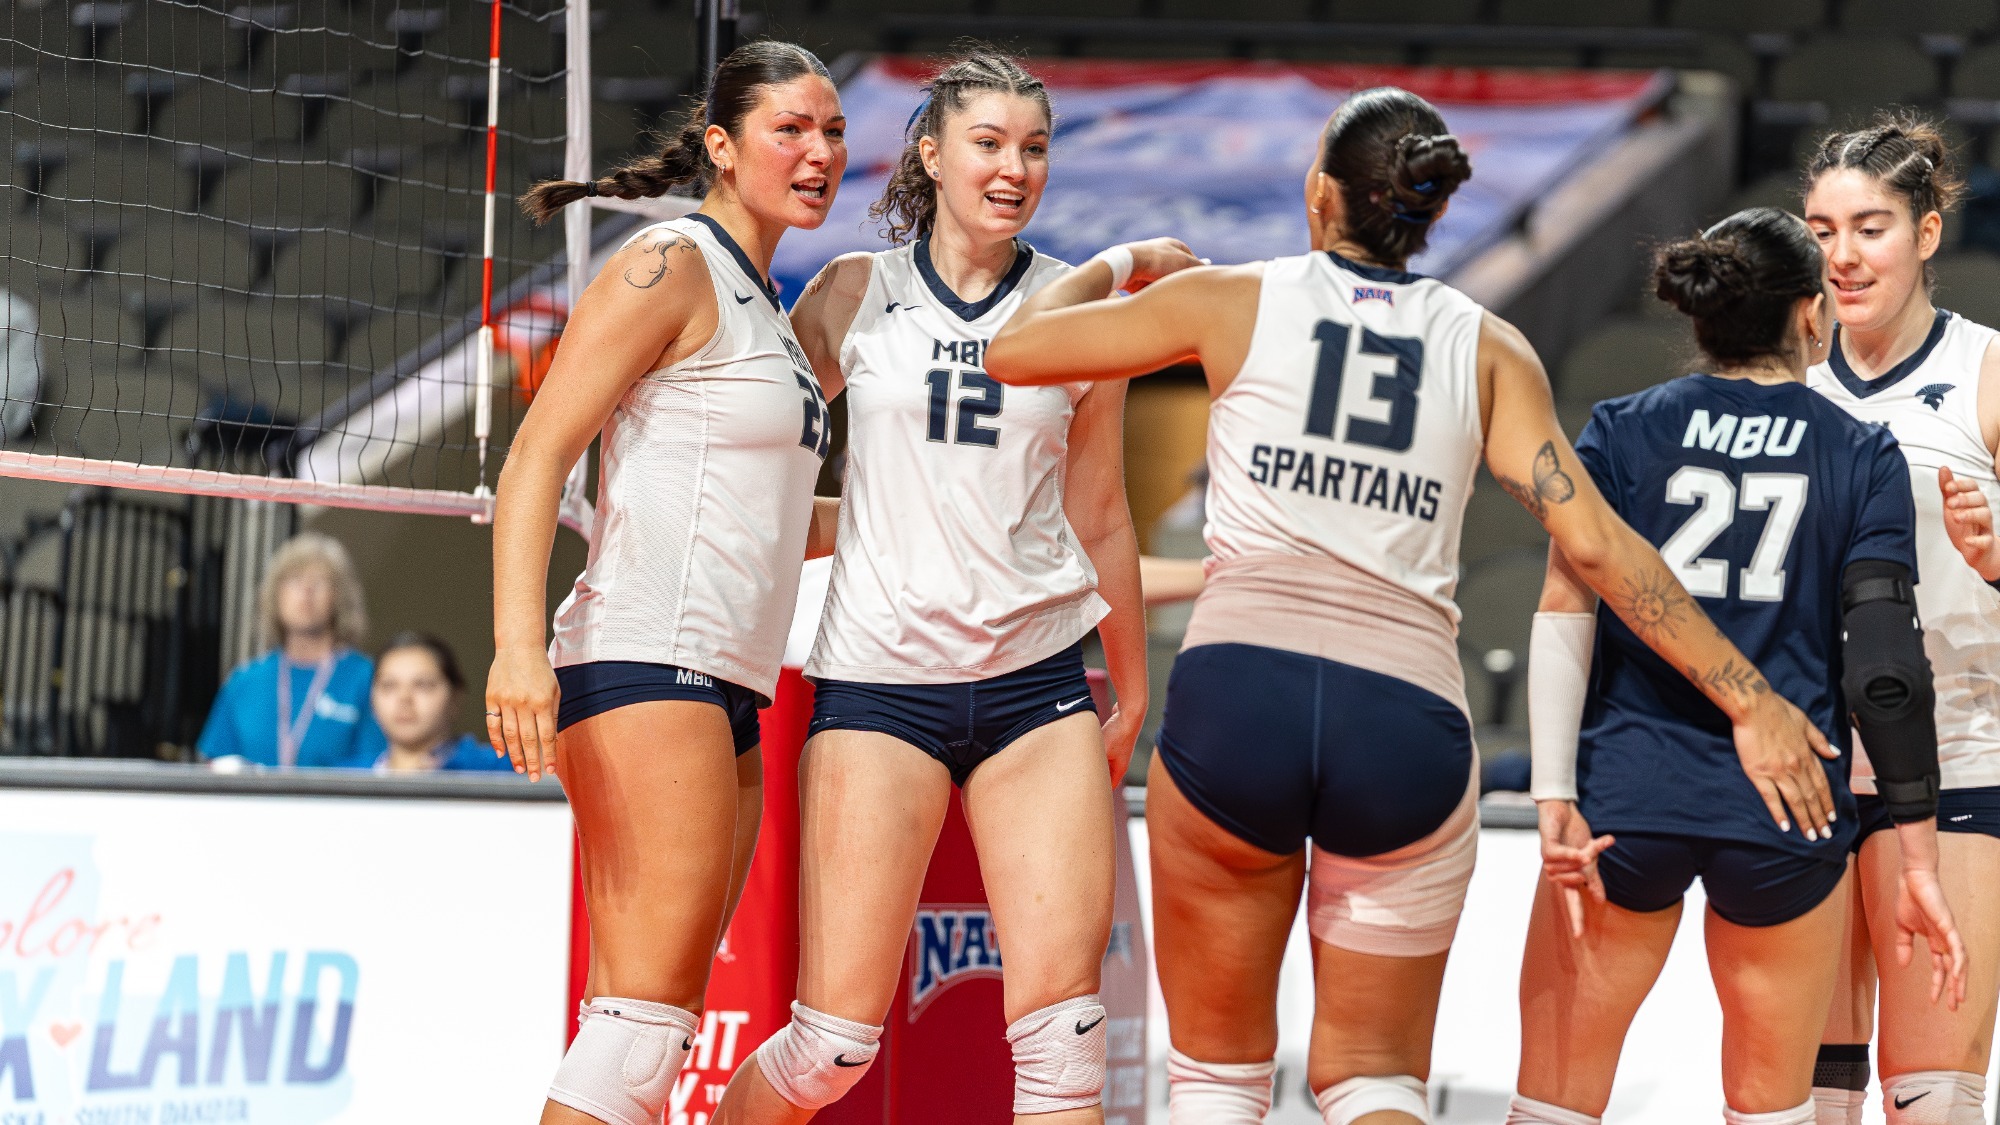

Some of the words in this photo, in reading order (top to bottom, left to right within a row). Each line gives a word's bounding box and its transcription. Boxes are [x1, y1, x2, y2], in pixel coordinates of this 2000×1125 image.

[1352, 286, 1394, 308] NAIA
[924, 367, 1005, 450] 12
[1303, 318, 1425, 455] 13
[1682, 408, 1809, 460] MBU
[1248, 443, 1442, 523] SPARTANS
[1660, 465, 1810, 602] 27
[675, 668, 714, 688] MBU
[911, 910, 1004, 1005] NA
[85, 950, 361, 1093] LAND
